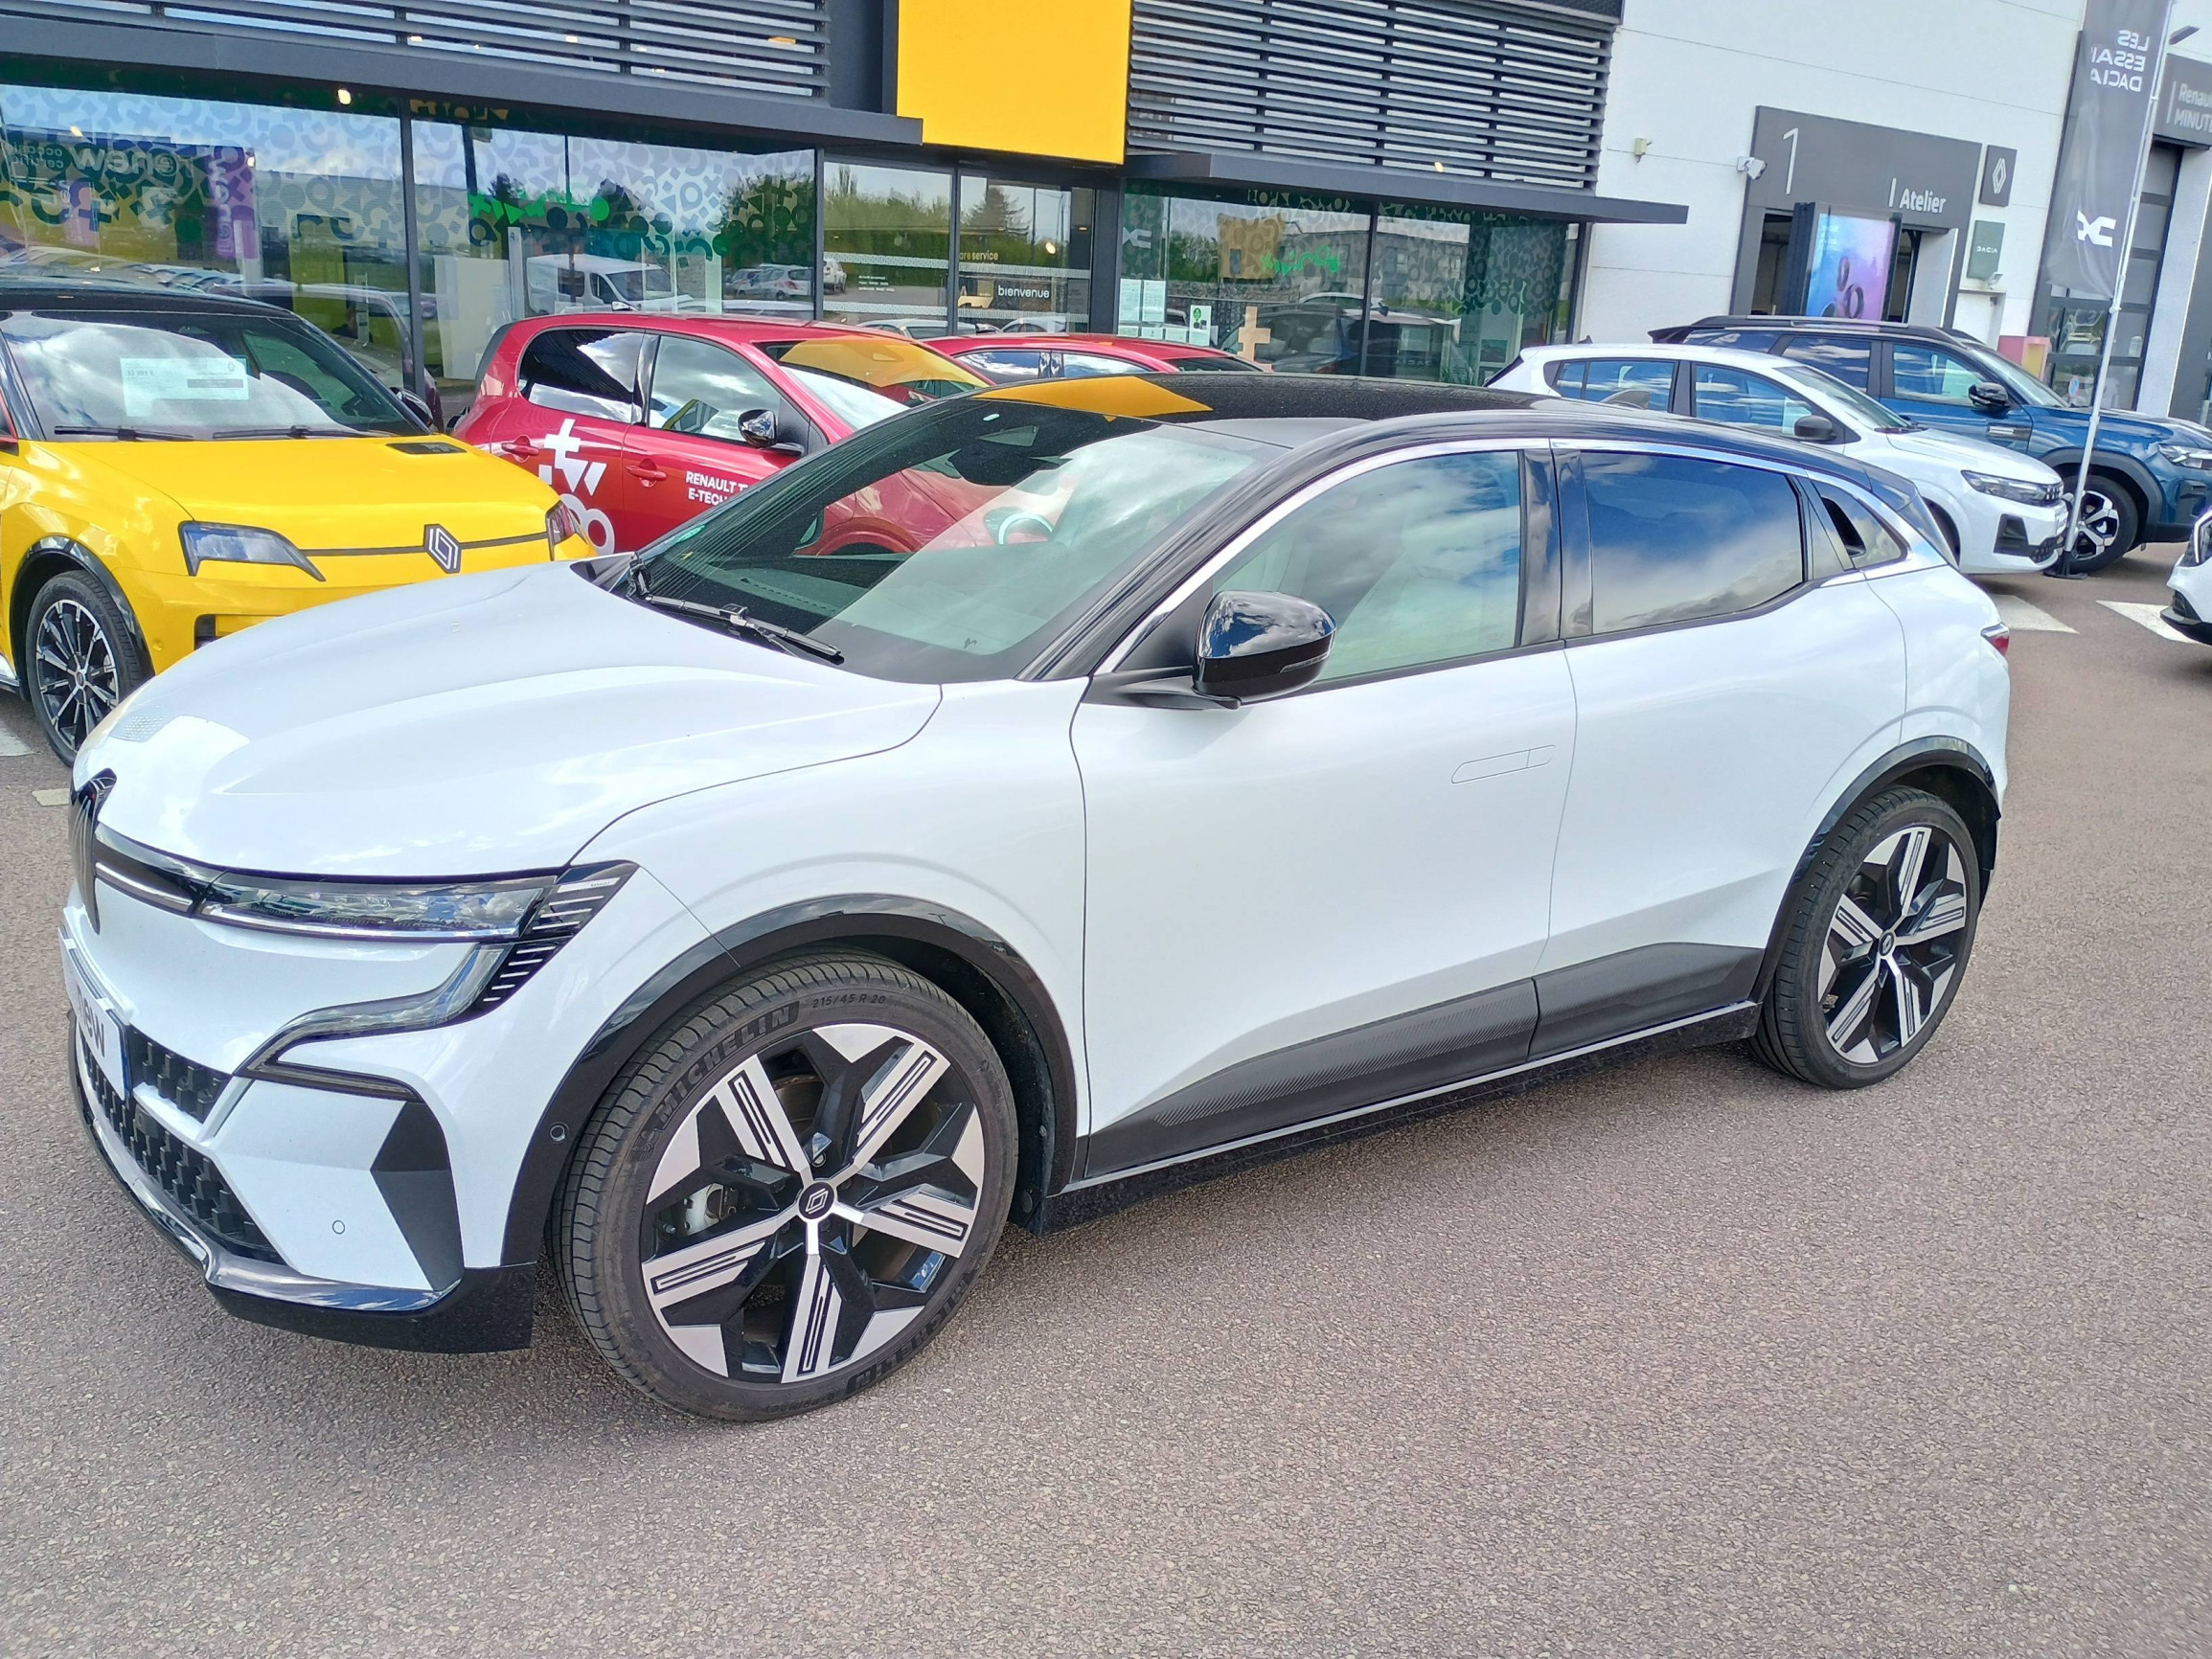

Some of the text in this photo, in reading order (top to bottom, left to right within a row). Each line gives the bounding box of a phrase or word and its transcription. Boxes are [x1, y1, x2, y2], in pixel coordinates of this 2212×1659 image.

[1899, 188, 1947, 214] Atelier
[971, 250, 998, 261] service
[1976, 245, 1998, 254] DACIA
[997, 284, 1050, 300] bienvenue
[686, 470, 738, 494] RENAULT
[812, 993, 886, 1009] 215/45 R 20
[655, 1006, 791, 1124] MICHELIN
